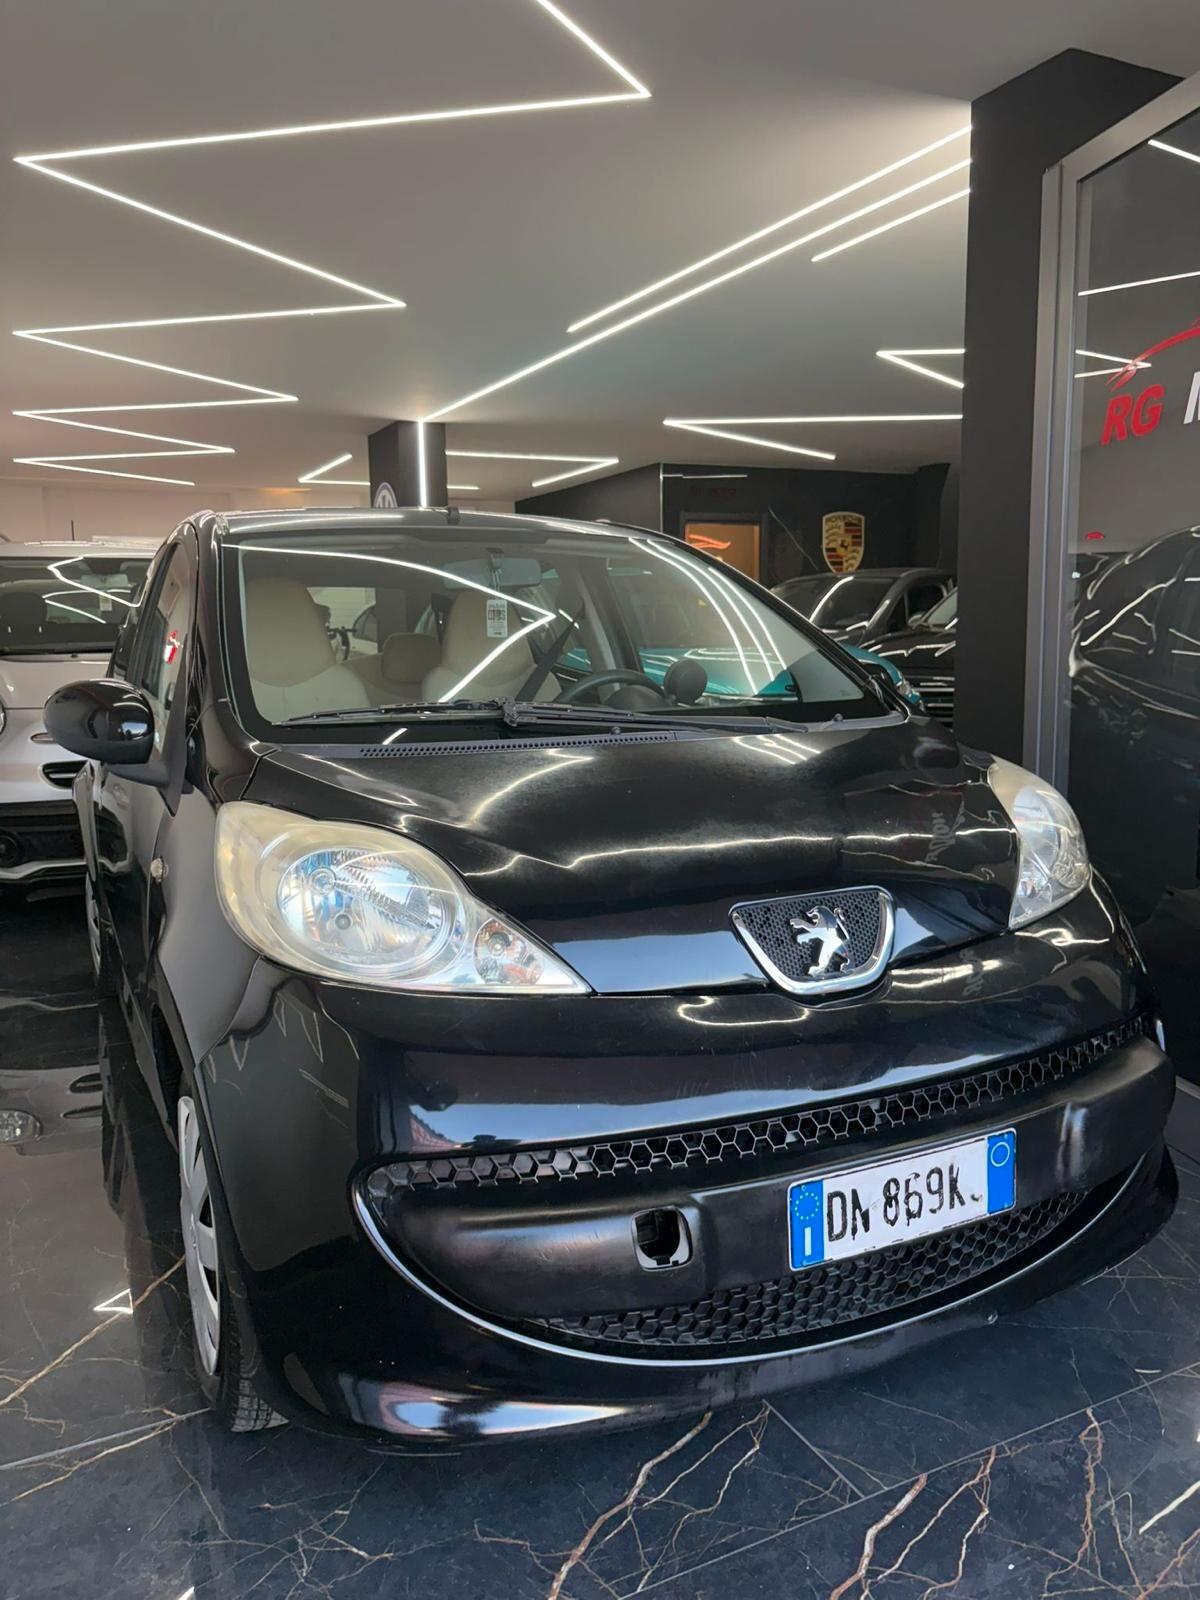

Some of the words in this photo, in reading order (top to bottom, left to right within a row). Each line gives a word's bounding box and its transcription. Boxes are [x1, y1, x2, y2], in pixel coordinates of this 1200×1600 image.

[1101, 384, 1164, 445] RG
[826, 1188, 870, 1241] DN
[882, 1163, 983, 1227] 869K
